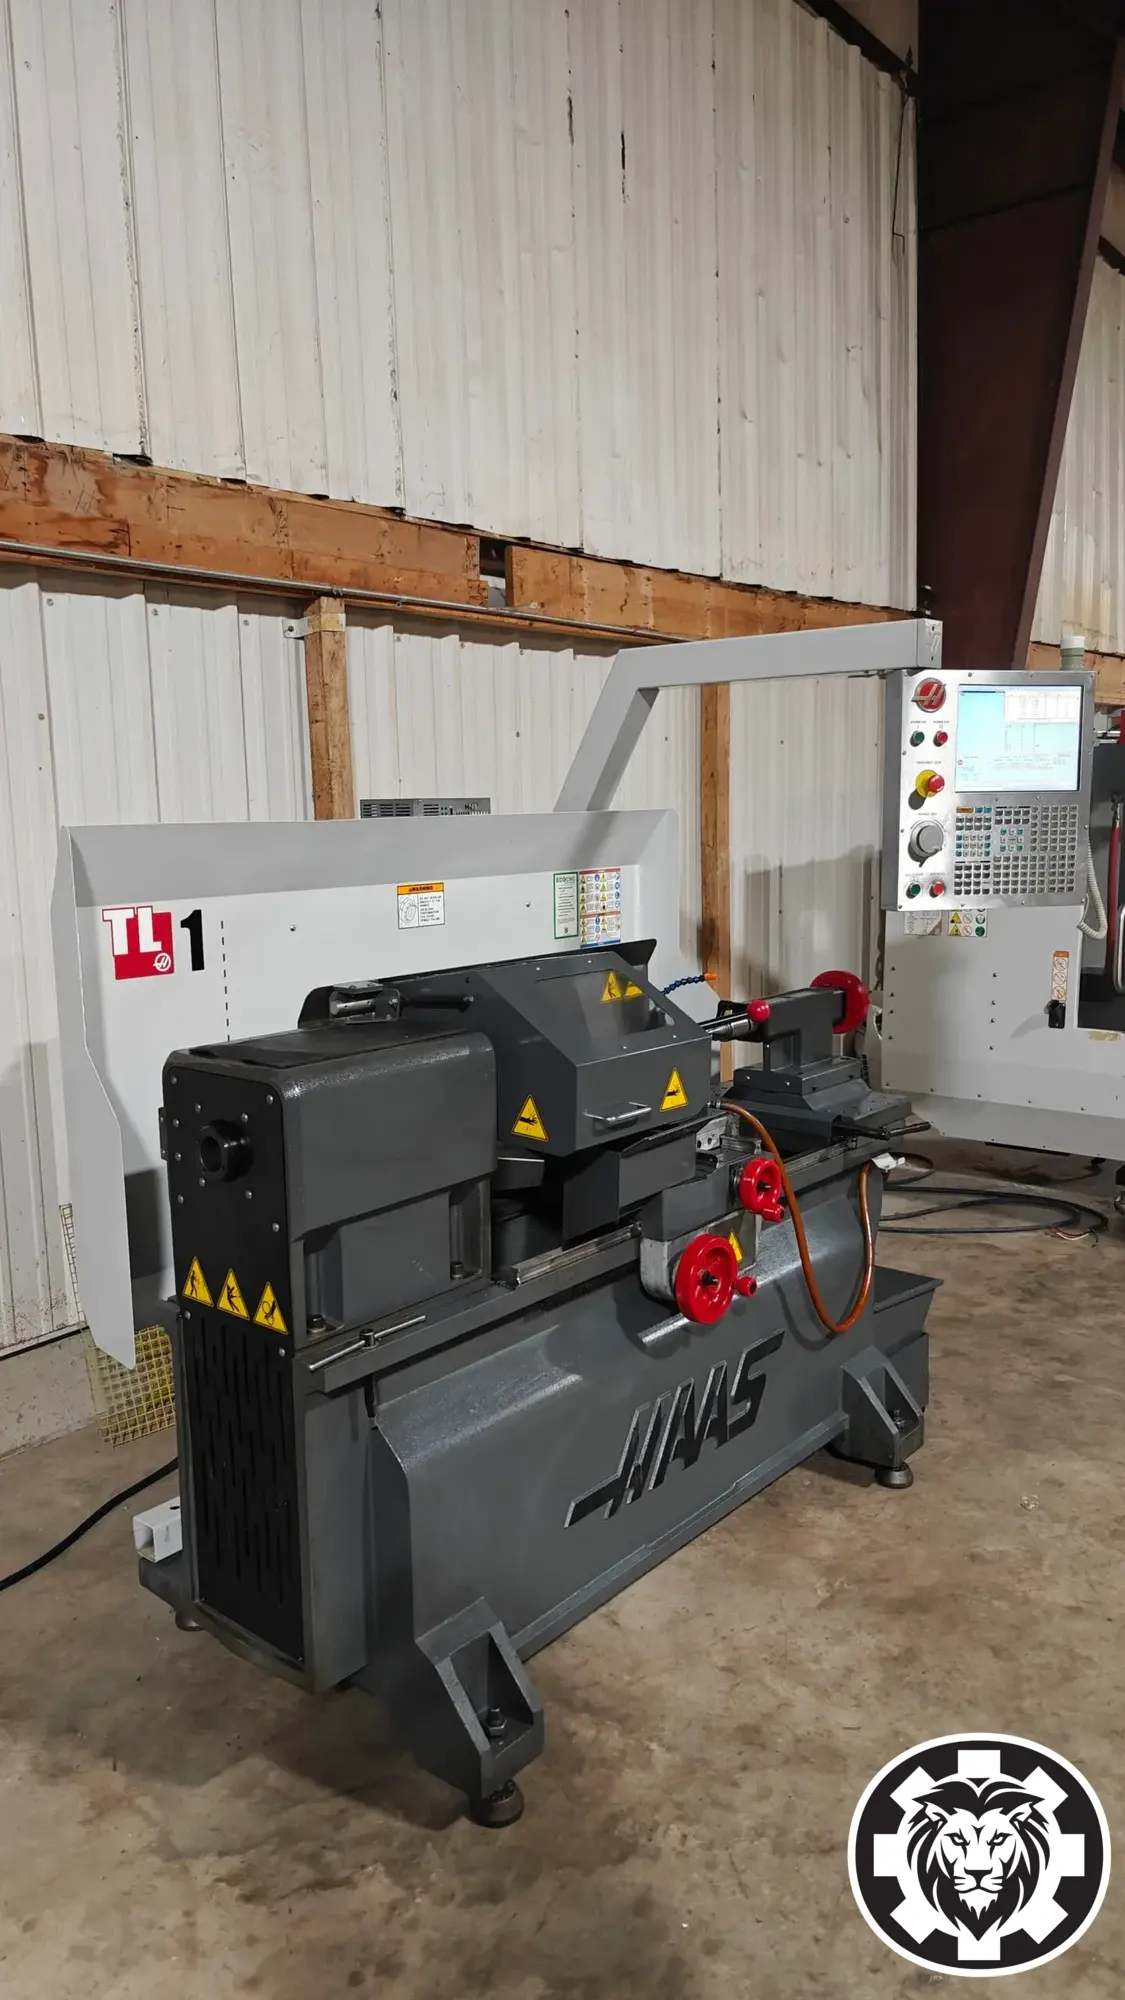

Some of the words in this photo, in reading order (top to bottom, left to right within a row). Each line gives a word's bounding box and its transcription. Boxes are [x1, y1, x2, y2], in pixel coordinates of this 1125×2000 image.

[102, 906, 162, 956] TL
[180, 909, 205, 971] 1
[564, 1329, 785, 1529] HAAS
